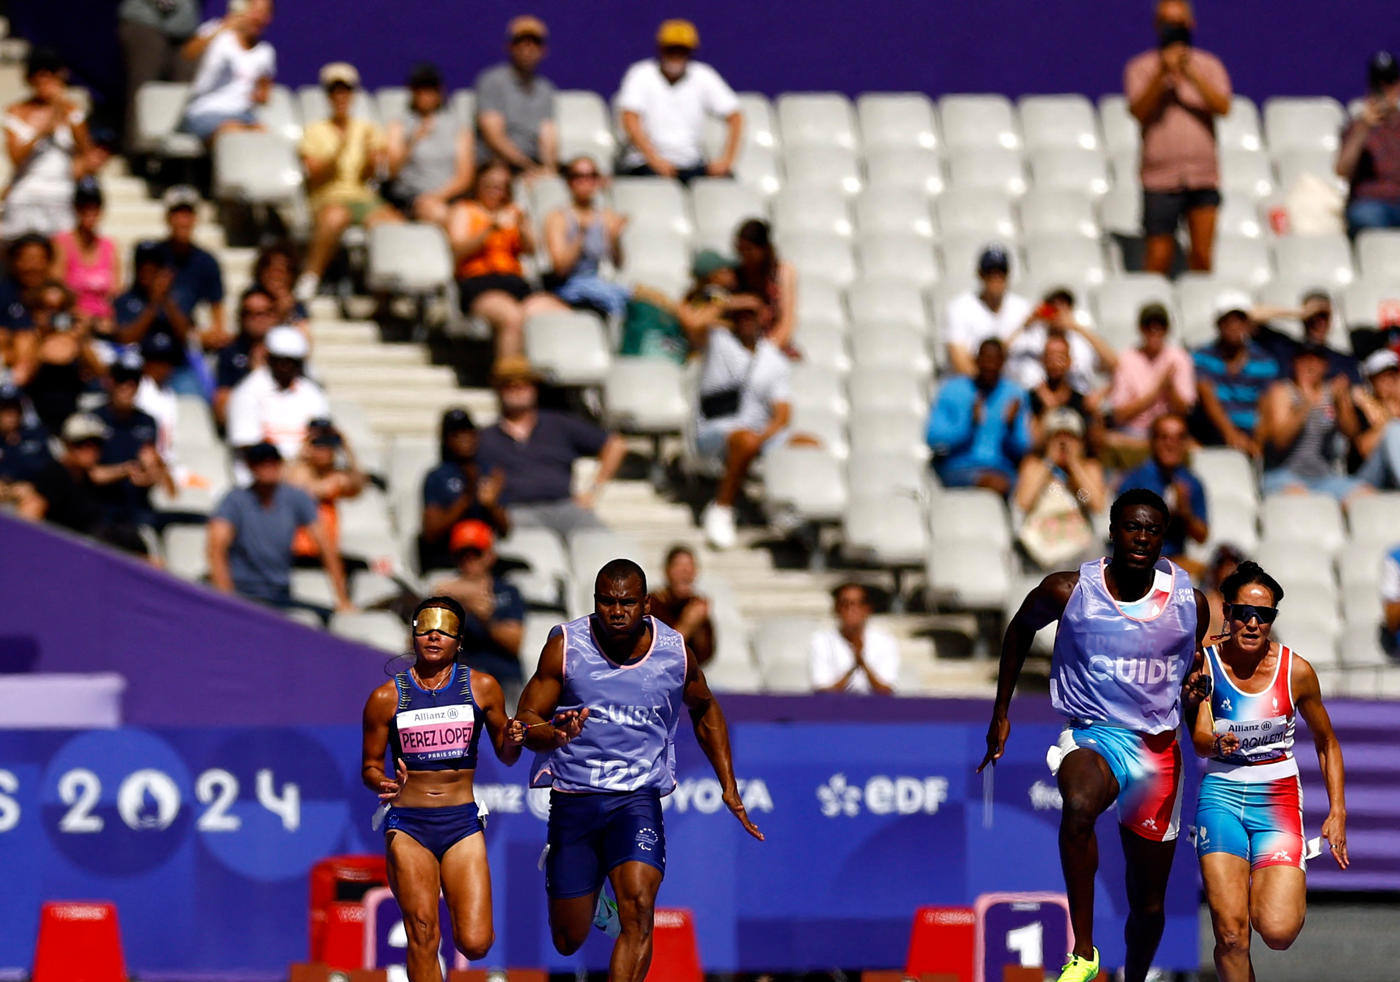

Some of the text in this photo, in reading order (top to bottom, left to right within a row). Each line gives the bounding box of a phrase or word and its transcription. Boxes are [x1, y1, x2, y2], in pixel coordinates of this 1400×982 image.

[1088, 653, 1181, 685] GUIDE
[414, 711, 447, 722] Allianz
[1228, 723, 1260, 733] Allianz
[402, 727, 472, 748] PEREZ LOPEZ
[58, 769, 300, 832] 2024
[1006, 919, 1044, 967] 1
